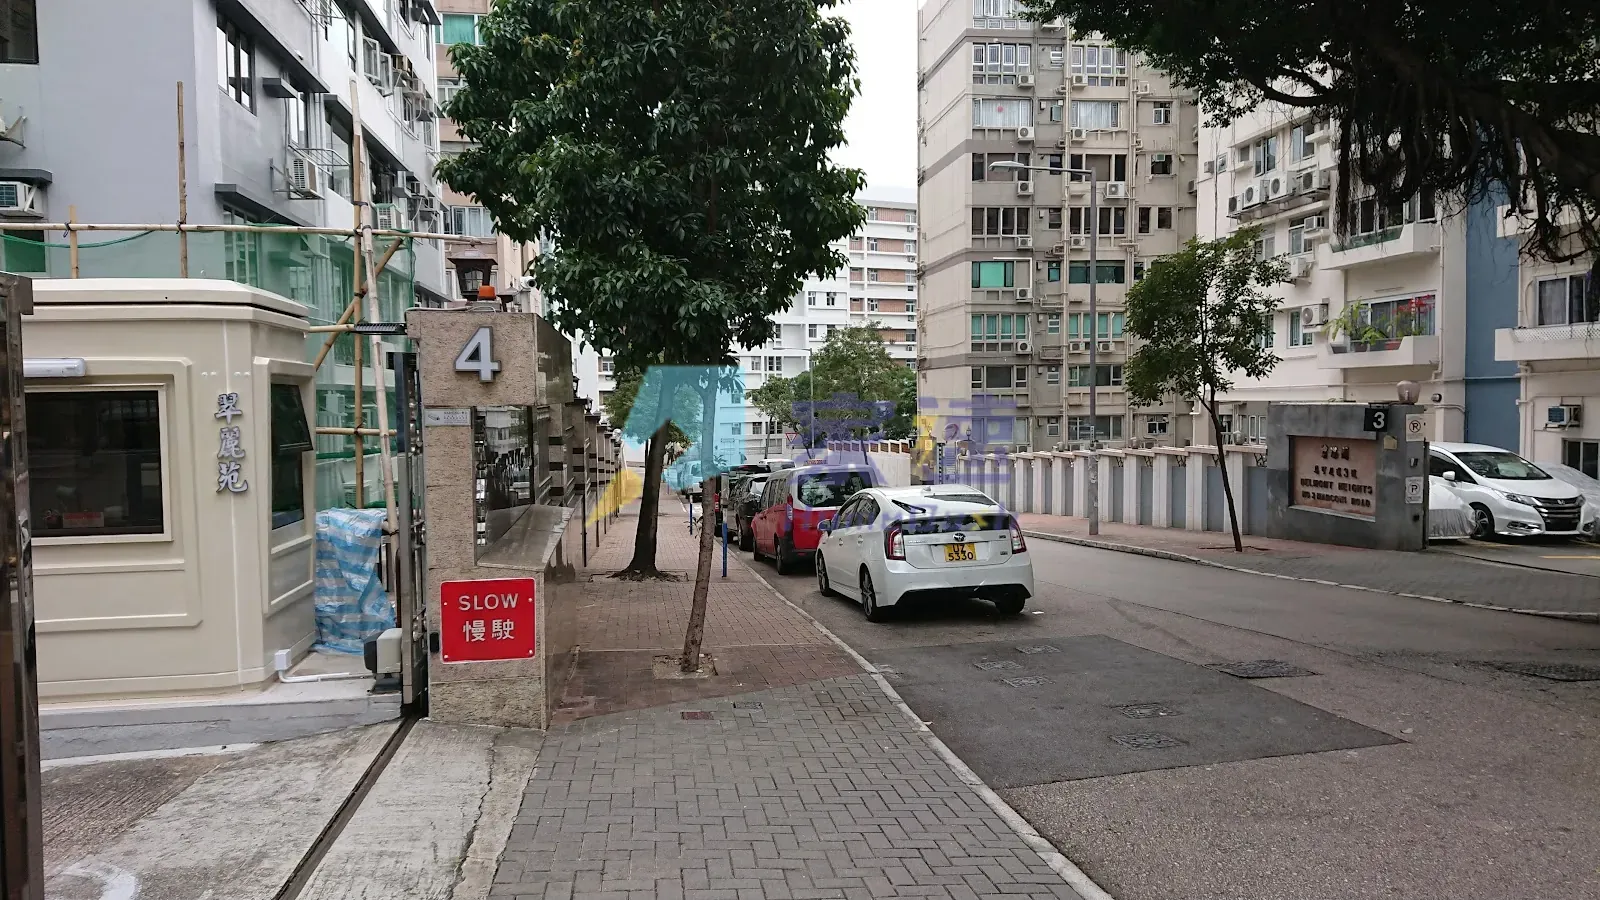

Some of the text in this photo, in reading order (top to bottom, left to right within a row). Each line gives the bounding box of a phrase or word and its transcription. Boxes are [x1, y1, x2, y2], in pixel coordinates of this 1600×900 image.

[453, 325, 502, 383] 4
[1373, 411, 1385, 429] 3
[214, 392, 248, 494] 翠麗苑
[948, 551, 974, 561] 5330
[459, 593, 519, 611] SLOW
[463, 619, 515, 642] 慢駛
